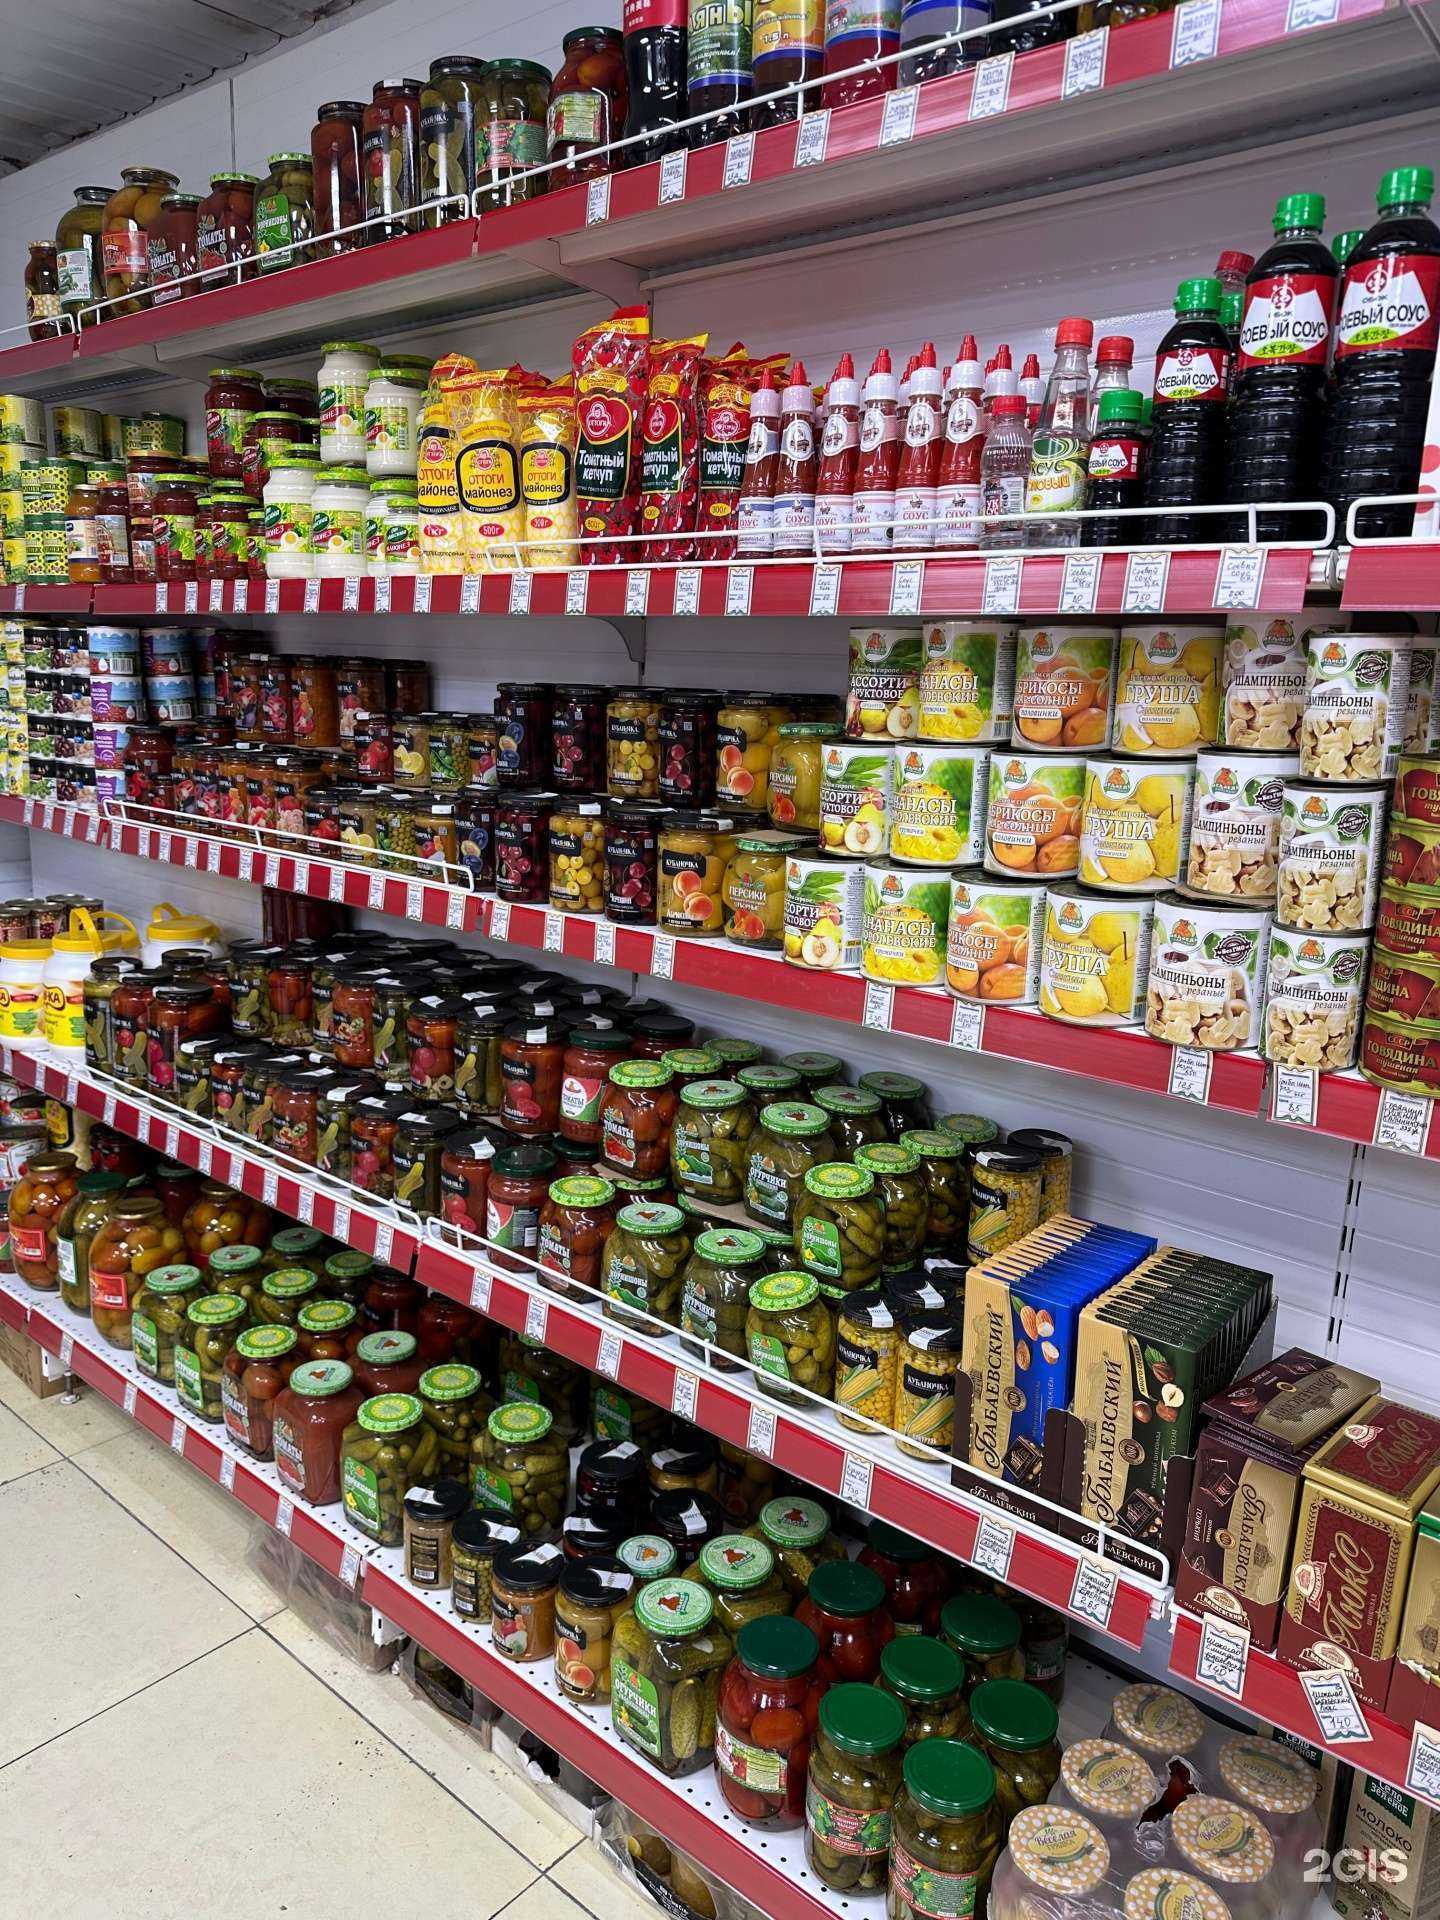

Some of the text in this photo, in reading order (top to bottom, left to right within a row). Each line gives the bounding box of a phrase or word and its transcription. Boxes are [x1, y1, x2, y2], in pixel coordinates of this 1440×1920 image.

[1385, 304, 1426, 322] СОУС
[1292, 320, 1326, 338] СОУС
[1192, 373, 1217, 386] СОУС
[579, 448, 625, 468] Томатный
[707, 462, 741, 478] кетчуп
[1031, 459, 1065, 474] КСУС
[468, 474, 505, 485] ОТТОГИ
[528, 471, 557, 482] ОТТОГИ
[583, 466, 614, 482] кетчуп
[465, 487, 513, 499] майонез
[524, 483, 563, 493] майонез
[785, 514, 811, 526] СОУС
[902, 511, 930, 521] СОУС
[483, 525, 500, 535] 500г
[1016, 681, 1083, 695] БРИКОСЫ
[1234, 674, 1307, 688] ШАМПИНЬО
[1125, 684, 1201, 704] ГРУША
[1283, 687, 1306, 698] реза
[1305, 696, 1374, 708] АМПИНЬОНЫ
[1336, 706, 1374, 717] резаные
[769, 771, 797, 785] ПЕРСИКИ
[821, 790, 863, 804] ССОРТИ
[989, 807, 1057, 822] БРИКОСЫ
[1083, 814, 1154, 840] ГРУША
[1227, 834, 1266, 845] резаные
[1318, 859, 1356, 869] резаные
[729, 886, 767, 901] ПЕРСИКИ
[785, 903, 820, 919] СОРТИ
[1380, 914, 1440, 938] ГОВЯДИНА
[1046, 948, 1109, 976] РУША
[1186, 985, 1226, 998] резаные
[1271, 980, 1349, 1002] ШАМПИНЬОНЫ
[1313, 999, 1348, 1010] резаные
[1367, 1040, 1440, 1067] ГОВЯДИНА
[604, 1119, 634, 1139] ТОМАТЫ
[750, 1167, 787, 1189] ОГУРЧИКИ
[1081, 1532, 1157, 1572] ББАЕВСКИЙ
[1207, 1663, 1228, 1677] 140
[615, 1677, 657, 1716] ОГУРЧИКИ
[1330, 1717, 1351, 1728] 140
[1355, 1803, 1413, 1852] МОЛОКО
